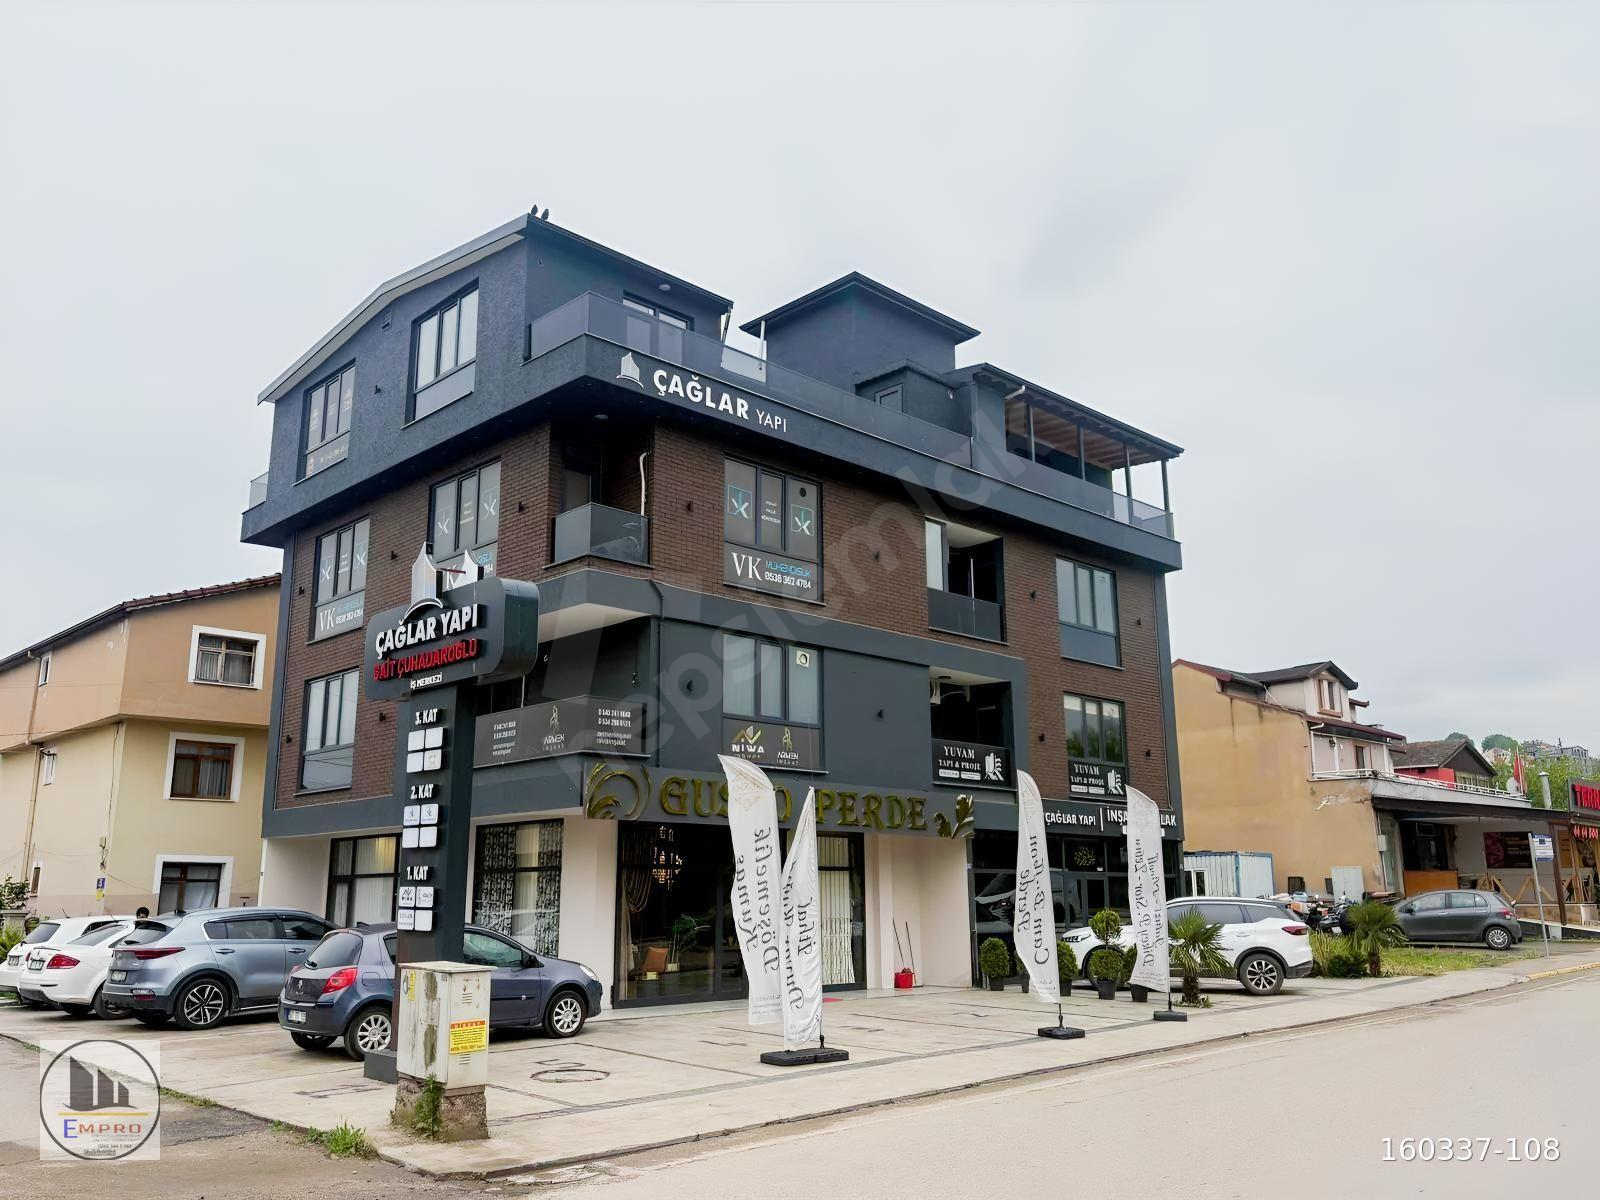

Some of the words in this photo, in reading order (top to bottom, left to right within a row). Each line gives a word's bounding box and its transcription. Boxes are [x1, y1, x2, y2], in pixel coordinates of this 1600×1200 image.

[653, 369, 749, 420] ÇAĞLAR
[756, 408, 787, 433] YAPI
[731, 552, 762, 581] VK
[319, 607, 336, 632] VK
[375, 616, 437, 660] ÇAĞLAR
[440, 603, 478, 636] YAPI
[415, 711, 422, 725] 3.
[422, 708, 439, 724] KAT
[943, 745, 975, 759] YUVAM
[938, 759, 954, 768] YAPI
[1073, 763, 1099, 776] YUVAM
[410, 785, 418, 800] 2.
[418, 783, 434, 798] KAT
[816, 789, 928, 831] PERDE
[1045, 809, 1077, 826] ÇAĞLAR
[1078, 814, 1096, 826] YAPI
[406, 866, 413, 880] 1.
[413, 865, 428, 881] KAT
